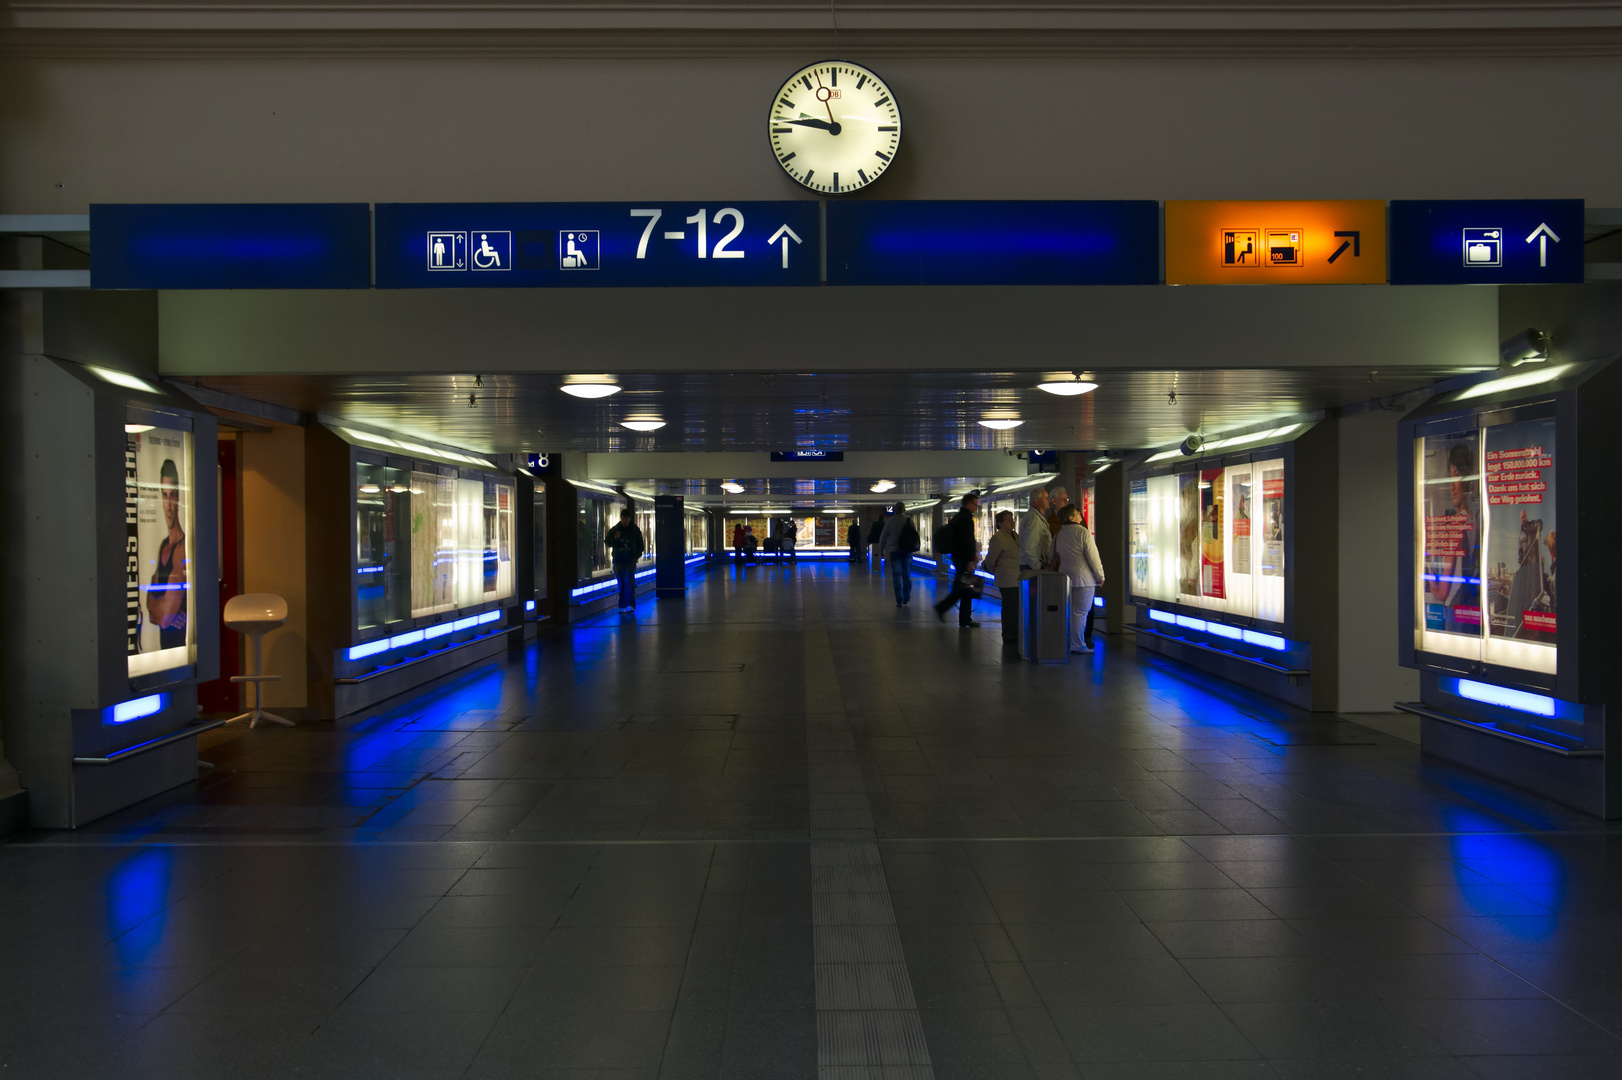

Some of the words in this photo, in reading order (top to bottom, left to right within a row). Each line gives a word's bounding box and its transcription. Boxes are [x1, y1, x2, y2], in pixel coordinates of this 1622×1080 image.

[630, 207, 745, 260] 7-12
[538, 453, 549, 467] 8
[1487, 451, 1498, 460] Ein
[1499, 446, 1542, 459] Sonnenstrahl
[1487, 462, 1502, 472] legt
[1539, 457, 1551, 467] km
[1500, 472, 1515, 481] Erde
[1515, 470, 1539, 480] zurück.
[1488, 484, 1507, 493] Dank
[1508, 484, 1518, 492] uns
[1519, 482, 1530, 491] hat
[1531, 481, 1546, 491] sich
[1490, 495, 1501, 504] der
[1501, 495, 1514, 505] Weg
[1515, 494, 1541, 504] gelohnt.
